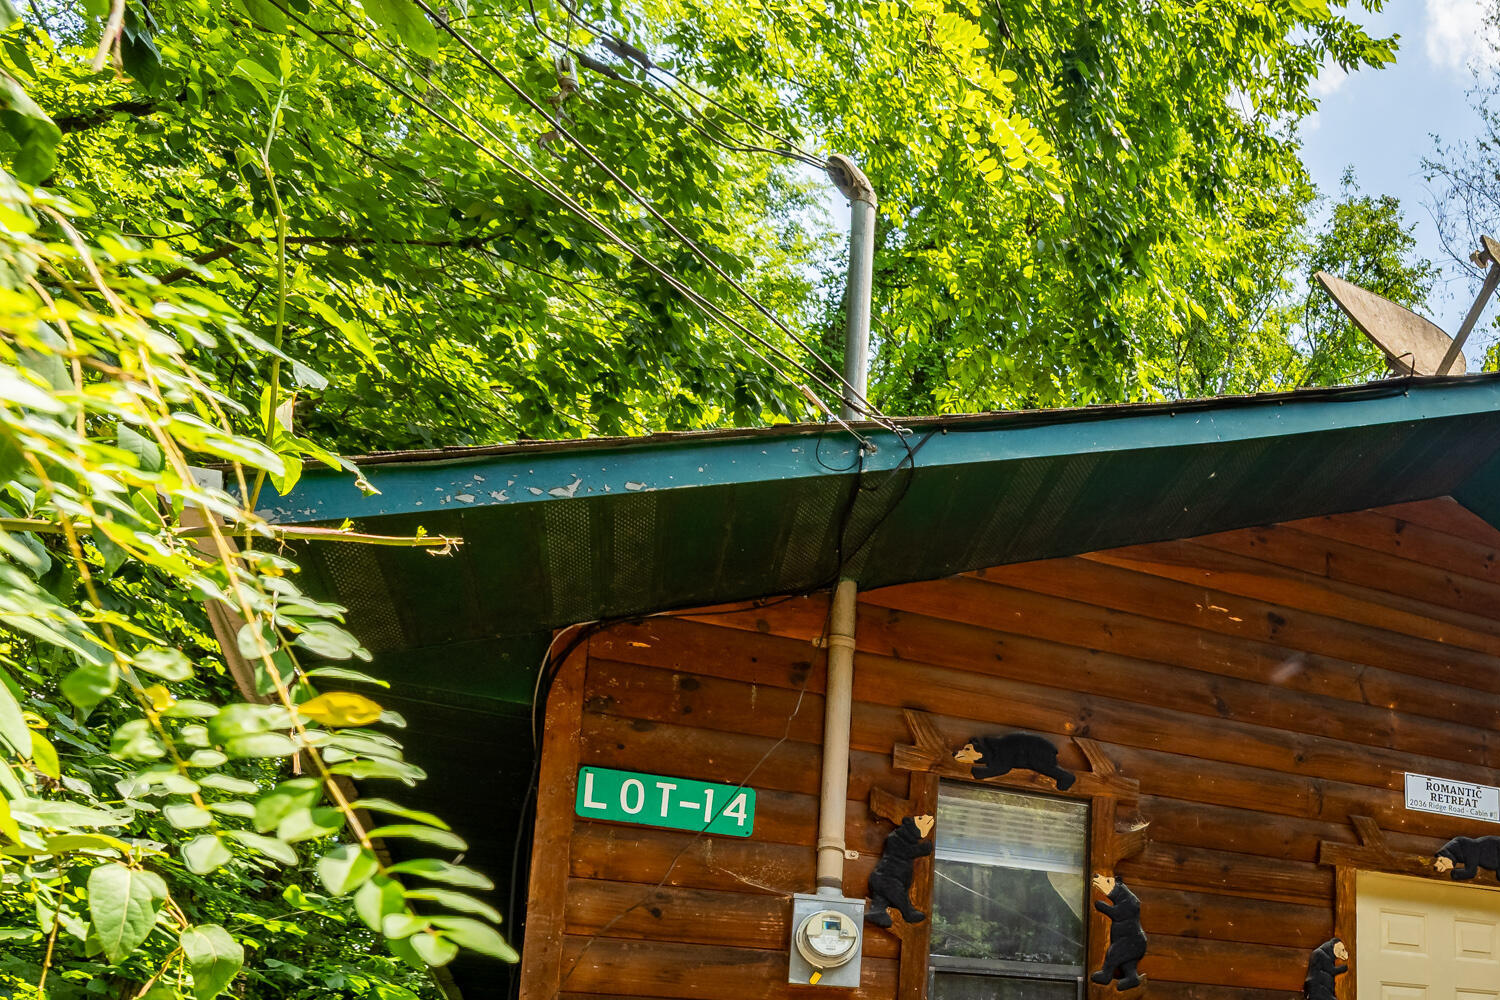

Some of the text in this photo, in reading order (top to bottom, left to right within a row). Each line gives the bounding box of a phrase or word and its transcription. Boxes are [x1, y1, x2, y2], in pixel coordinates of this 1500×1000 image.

[1426, 781, 1482, 799] ROMANTIC
[583, 772, 748, 827] LOT-14
[1409, 798, 1427, 808] 2036
[1428, 801, 1447, 812] Ridge
[1448, 804, 1465, 814] Road
[1469, 808, 1488, 817] Cabin
[1430, 792, 1479, 808] RETREAT
